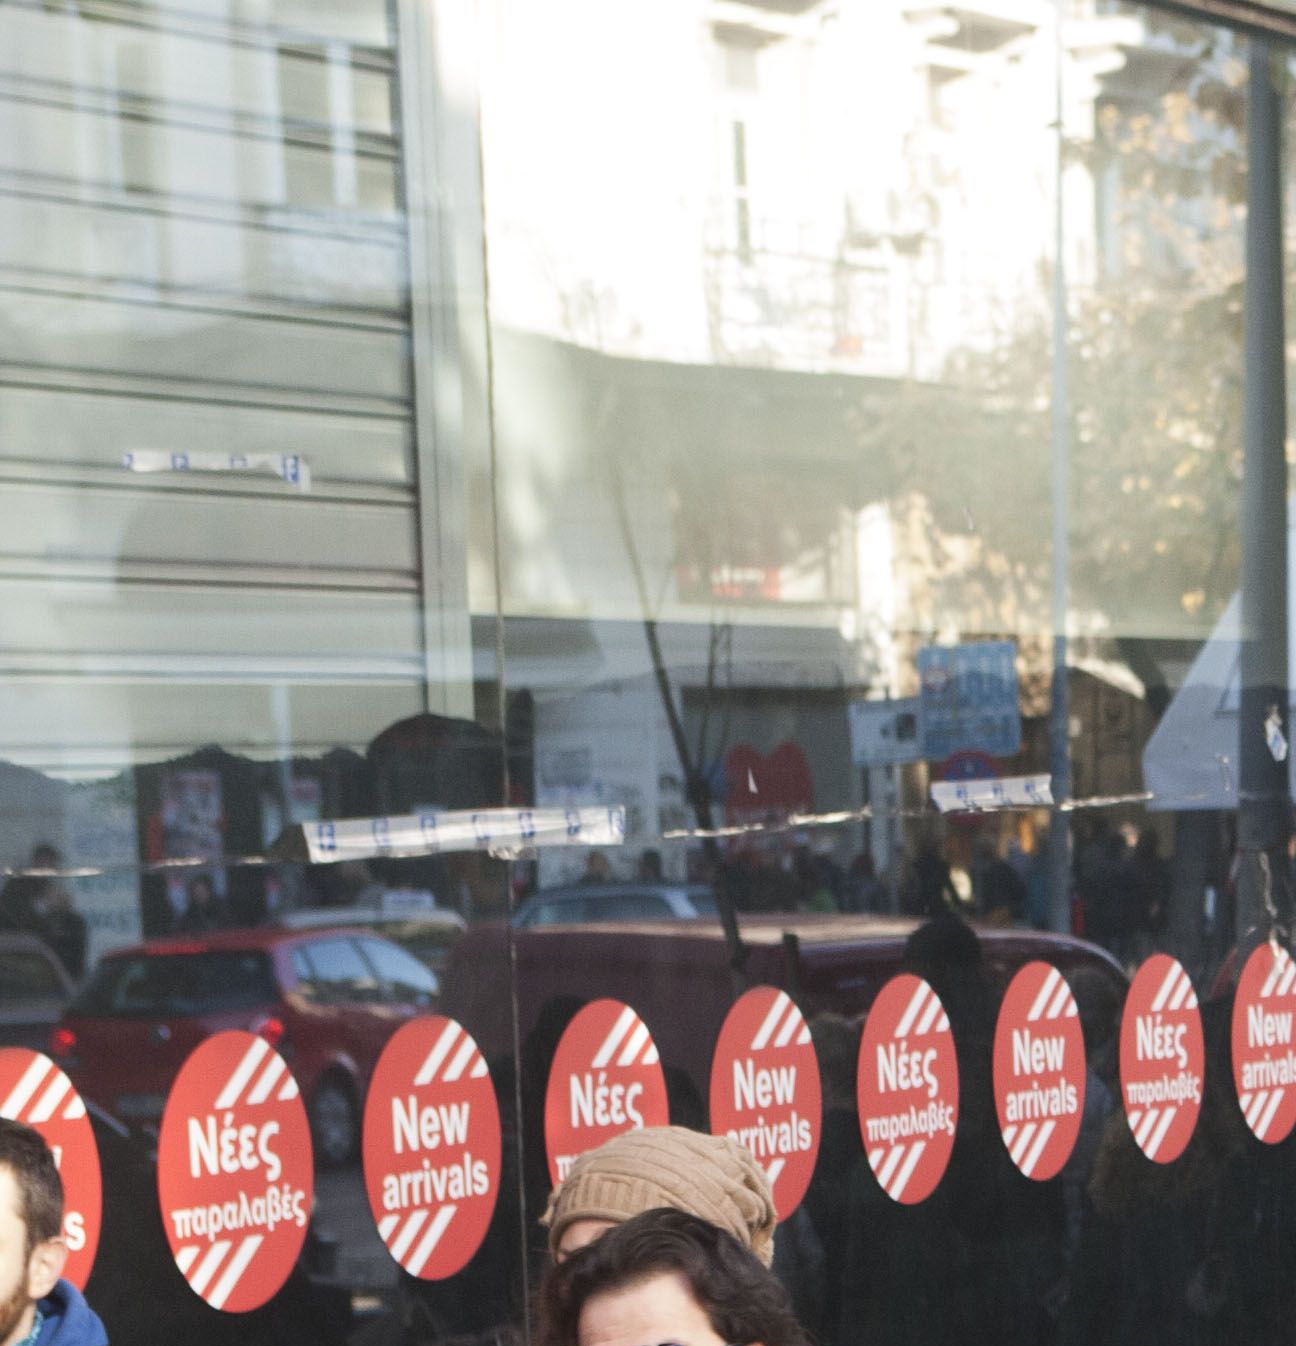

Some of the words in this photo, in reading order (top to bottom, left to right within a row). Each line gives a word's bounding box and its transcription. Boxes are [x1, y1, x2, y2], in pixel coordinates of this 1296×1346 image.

[1012, 1027, 1065, 1076] New
[1136, 1013, 1188, 1069] Νέες
[1248, 1003, 1293, 1049] New
[733, 1058, 796, 1111] New
[877, 1040, 938, 1098] Νέες
[1126, 1071, 1201, 1109] παραλαβές
[391, 1094, 470, 1154] New
[569, 1070, 645, 1130] Νέες
[866, 1099, 955, 1145] παραλαβές
[1006, 1076, 1078, 1122] arrivals
[187, 1110, 281, 1182] Νέες
[382, 1151, 489, 1211] arrivals
[171, 1183, 306, 1242] παραλαβές
